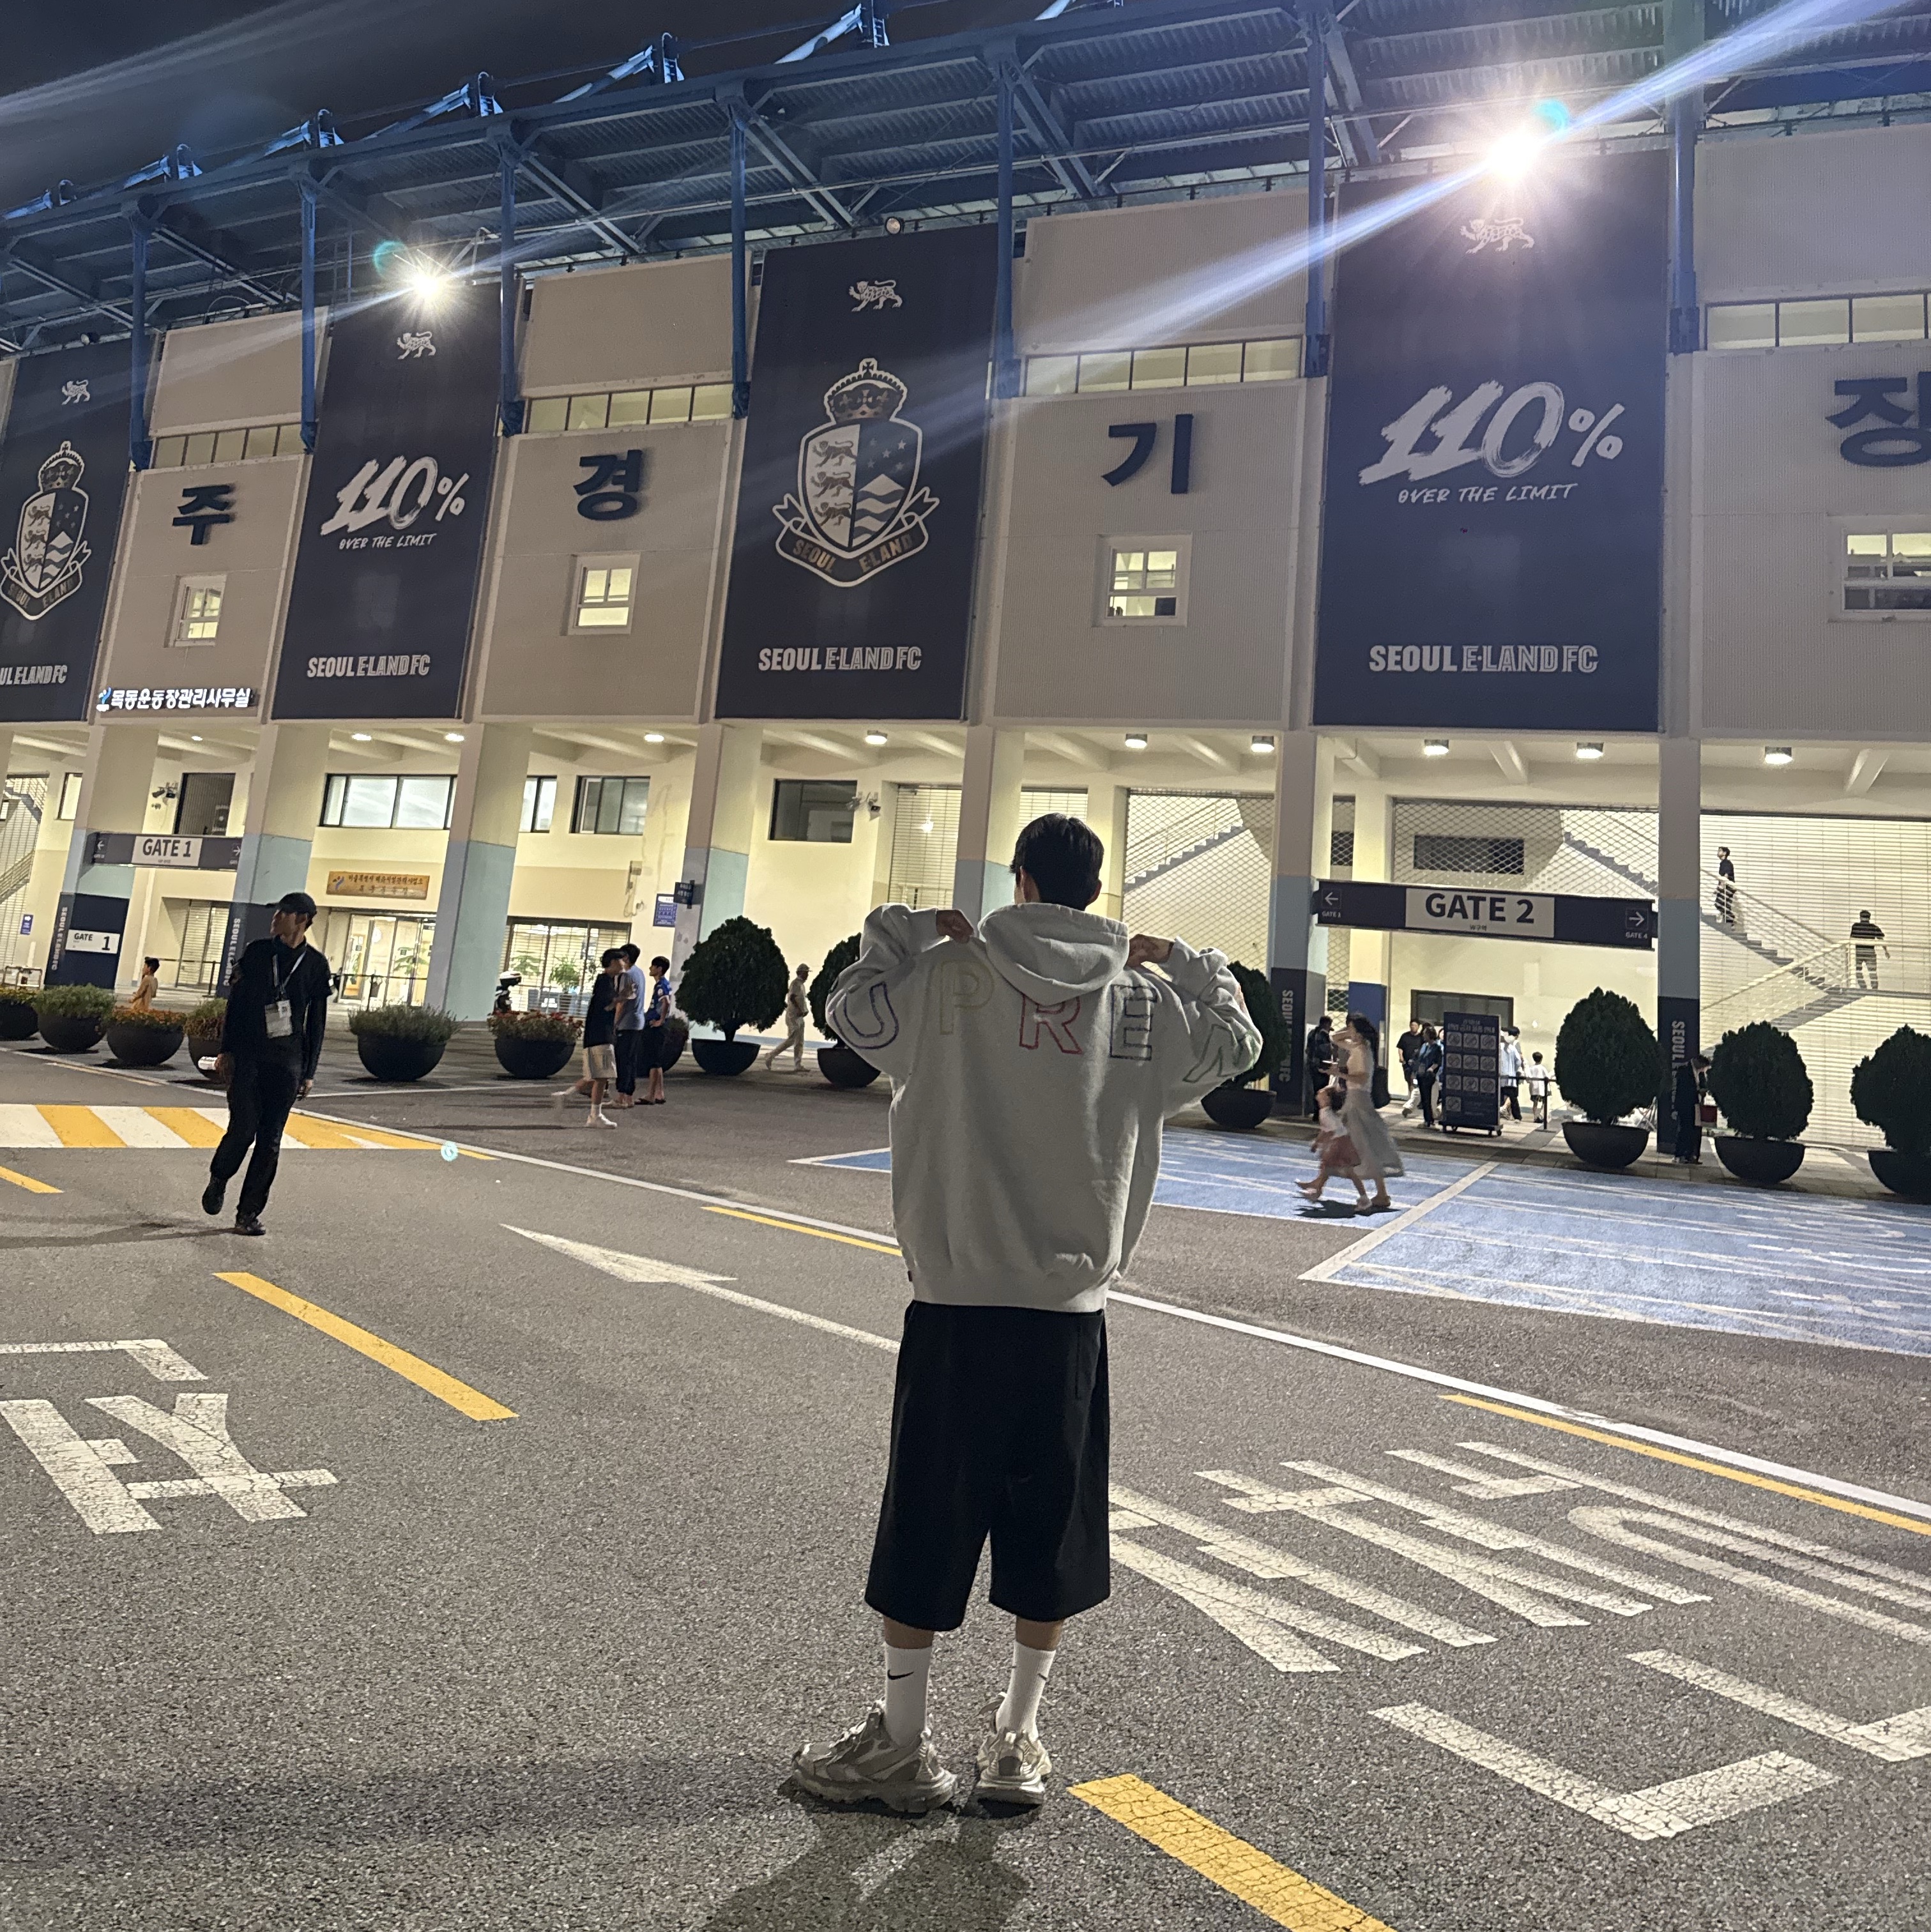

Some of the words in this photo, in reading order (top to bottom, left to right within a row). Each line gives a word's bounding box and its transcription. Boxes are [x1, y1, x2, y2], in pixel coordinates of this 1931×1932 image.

[1359, 379, 1624, 486] 110%
[320, 455, 469, 536] 110%
[1398, 489, 1449, 504] OVER
[1458, 487, 1498, 503] THE
[1506, 483, 1578, 502] LIMIT
[339, 538, 369, 550] OVER
[372, 536, 394, 549] THE
[396, 533, 438, 547] LIMIT
[793, 540, 837, 573] SEOUL
[307, 657, 355, 678] SEOUL
[409, 654, 431, 676] FC
[758, 647, 822, 671] SEOUL
[895, 646, 922, 671] FC
[1369, 644, 1458, 672] SEOUL
[1562, 644, 1599, 673] FC
[52, 665, 68, 684] FC
[111, 688, 251, 710] 목동운동장관리사무실
[142, 839, 181, 857] GATE
[183, 840, 192, 858] 1
[1424, 893, 1507, 922] GATE
[1516, 899, 1535, 924] 2
[74, 932, 93, 941] GATE
[102, 936, 111, 950] 1
[1672, 1021, 1686, 1061] SEOUL
